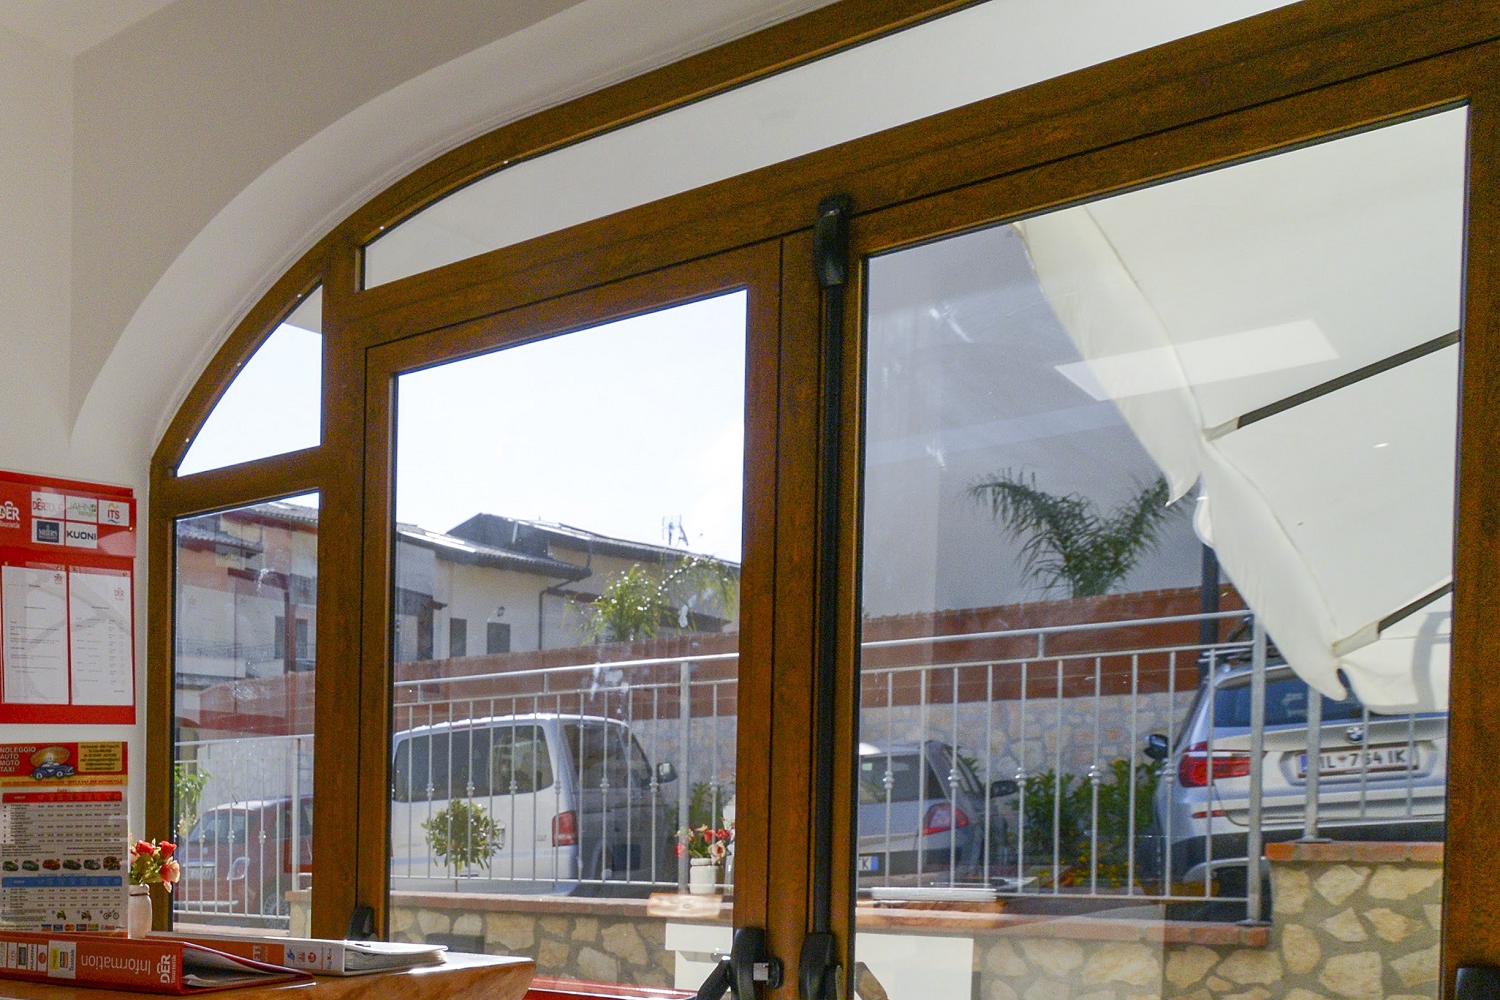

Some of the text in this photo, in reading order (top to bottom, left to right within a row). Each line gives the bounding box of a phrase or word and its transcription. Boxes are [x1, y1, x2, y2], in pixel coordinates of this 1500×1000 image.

[0, 501, 20, 520] DER
[107, 509, 120, 520] ITS
[66, 531, 97, 541] KUONI
[81, 954, 151, 976] Information
[157, 954, 171, 984] DER
